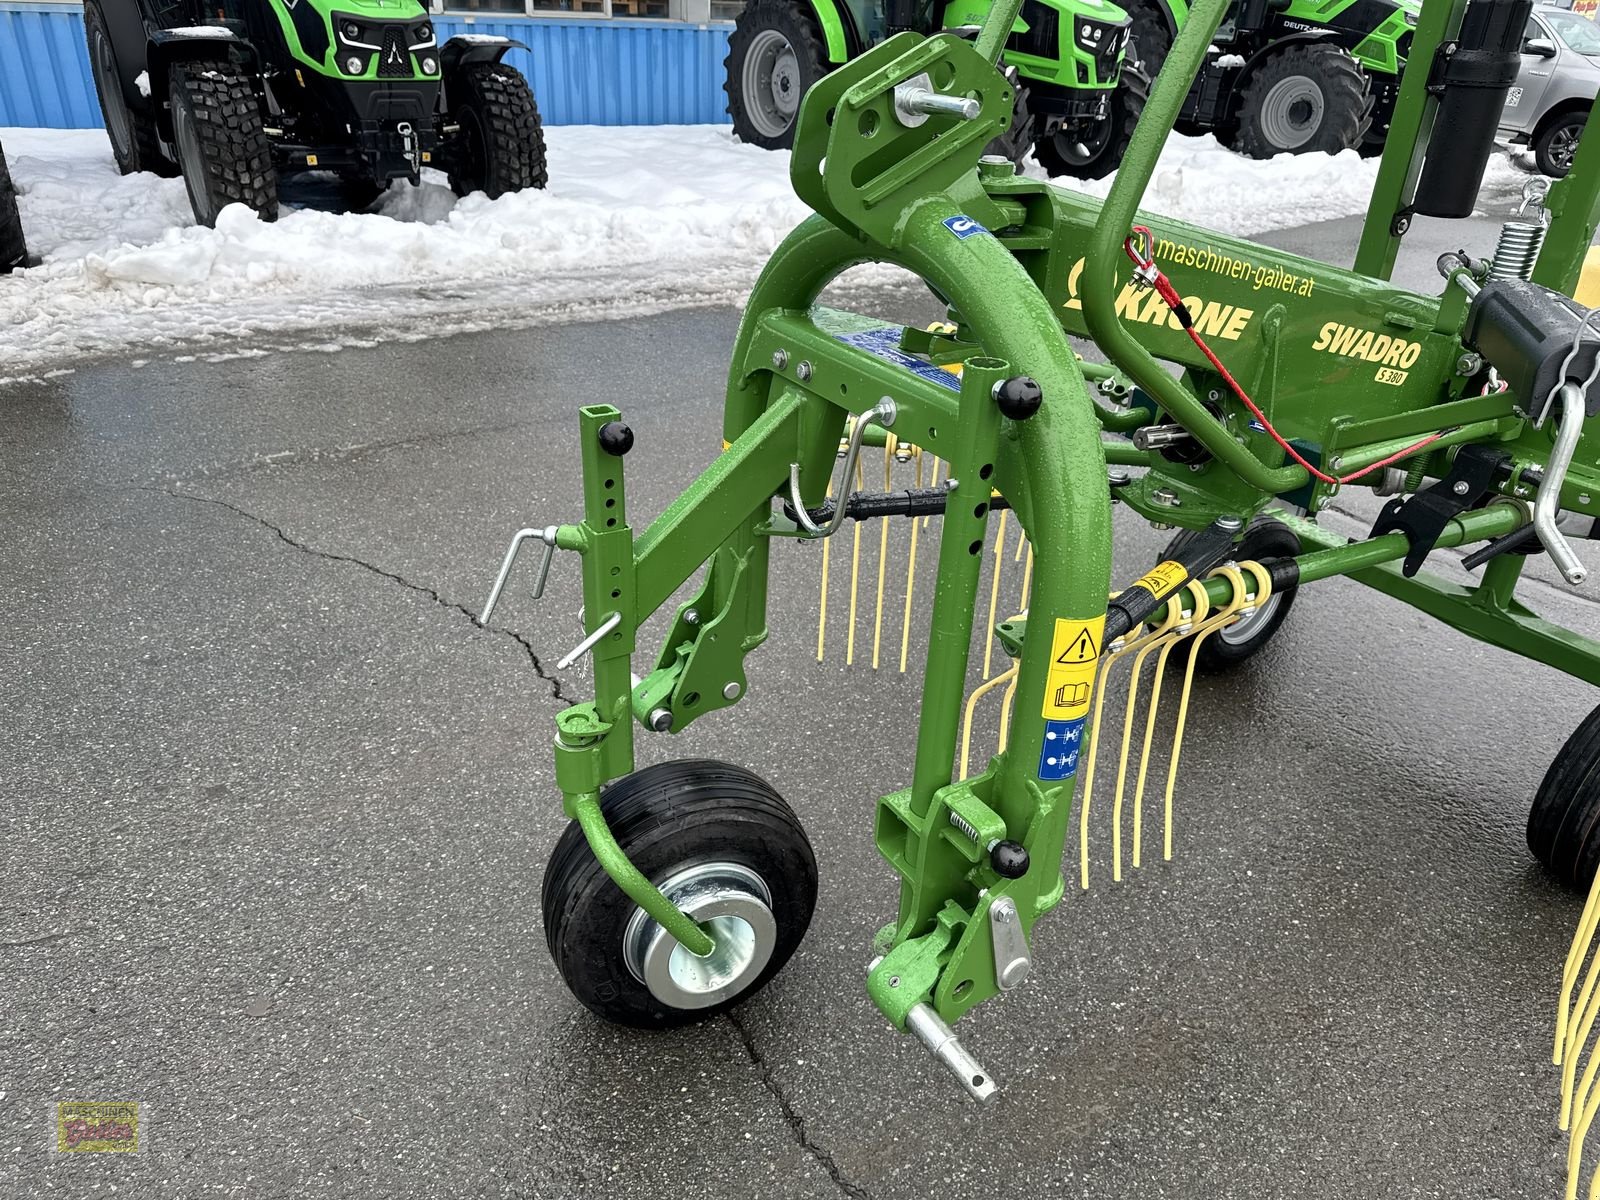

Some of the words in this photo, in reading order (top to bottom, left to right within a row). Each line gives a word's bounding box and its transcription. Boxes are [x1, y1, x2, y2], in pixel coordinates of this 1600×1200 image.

[1114, 282, 1254, 341] KRONE
[1311, 321, 1422, 369] SWADRO
[1378, 369, 1388, 381] S
[1385, 371, 1404, 384] 380
